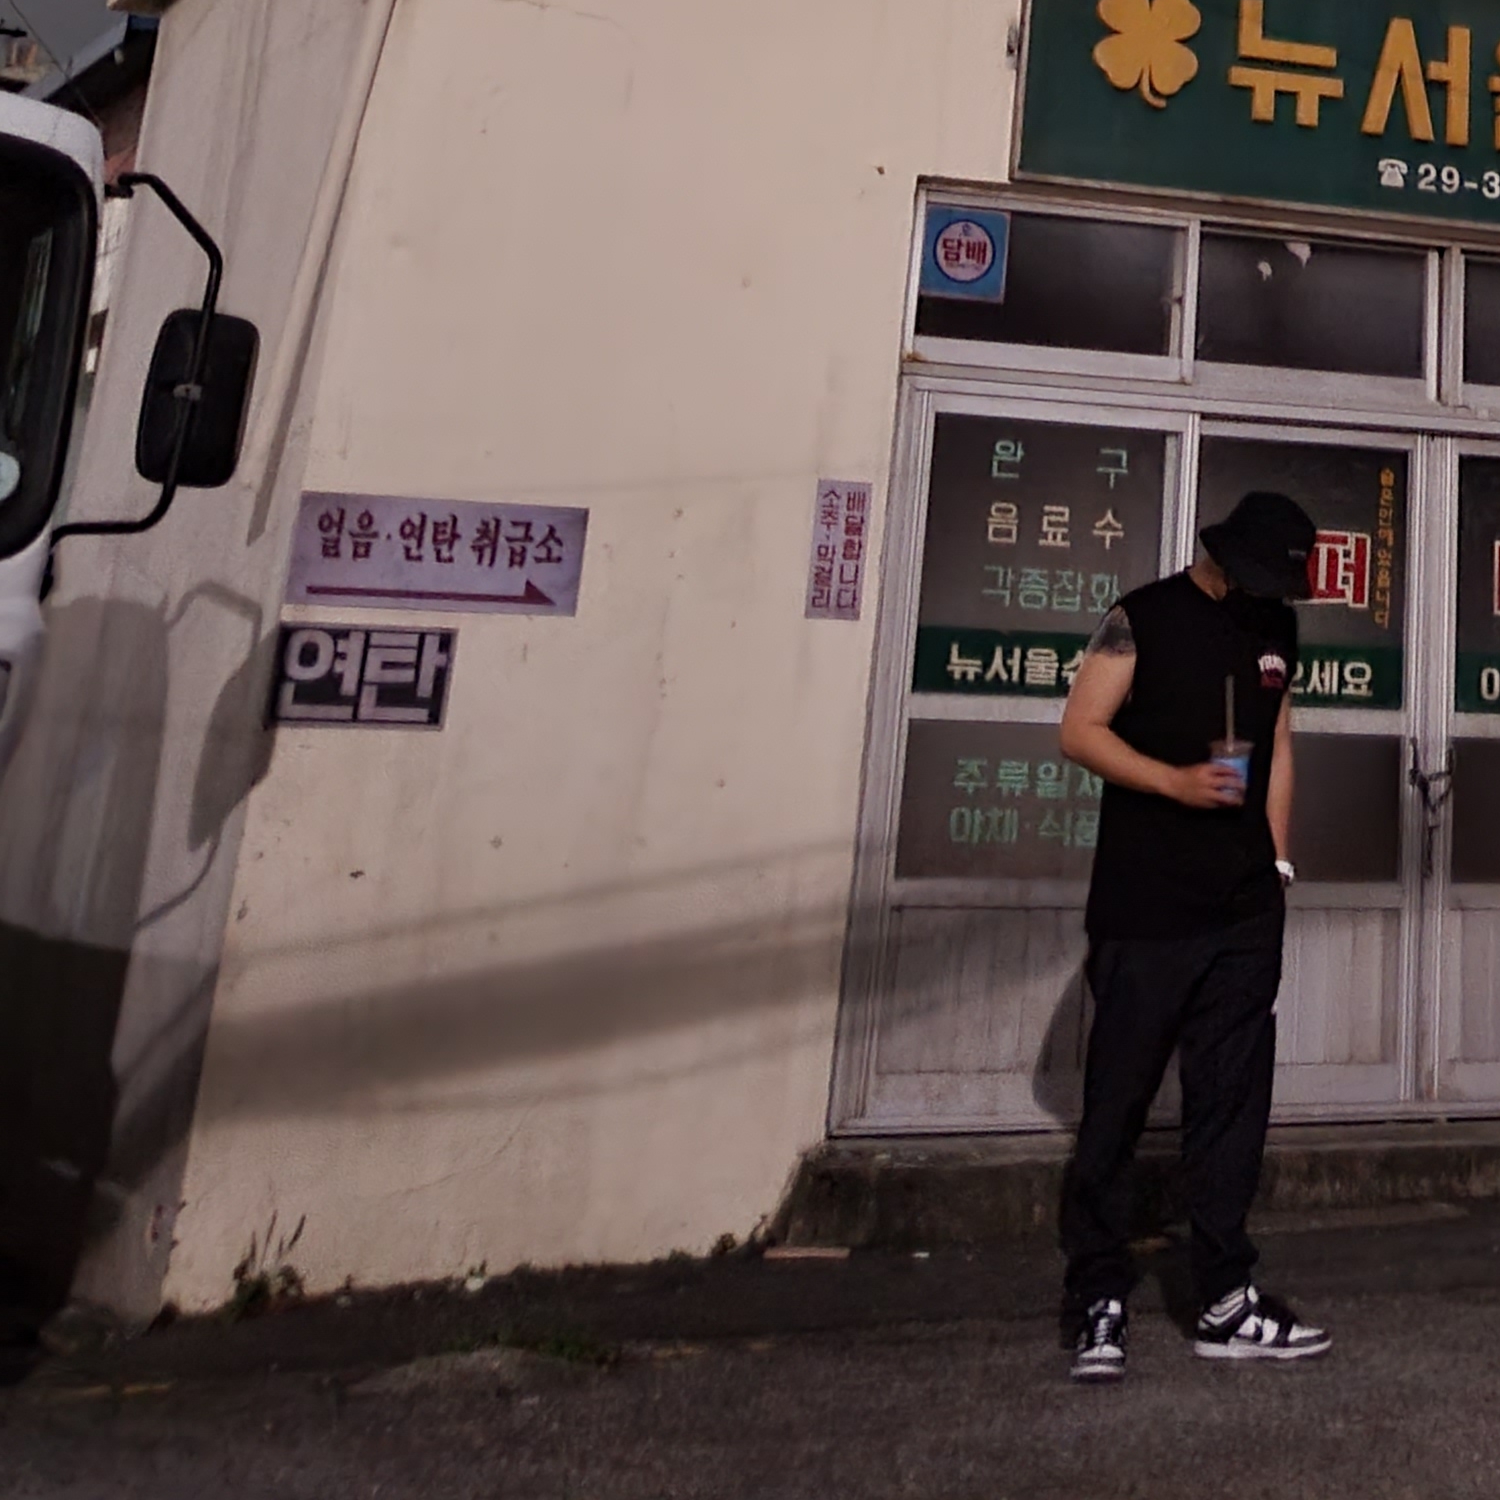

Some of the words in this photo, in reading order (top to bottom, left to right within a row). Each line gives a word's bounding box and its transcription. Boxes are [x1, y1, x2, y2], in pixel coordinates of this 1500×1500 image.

[942, 238, 987, 266] 담배
[1306, 529, 1372, 609] 퍼
[277, 628, 448, 722] 연탄
